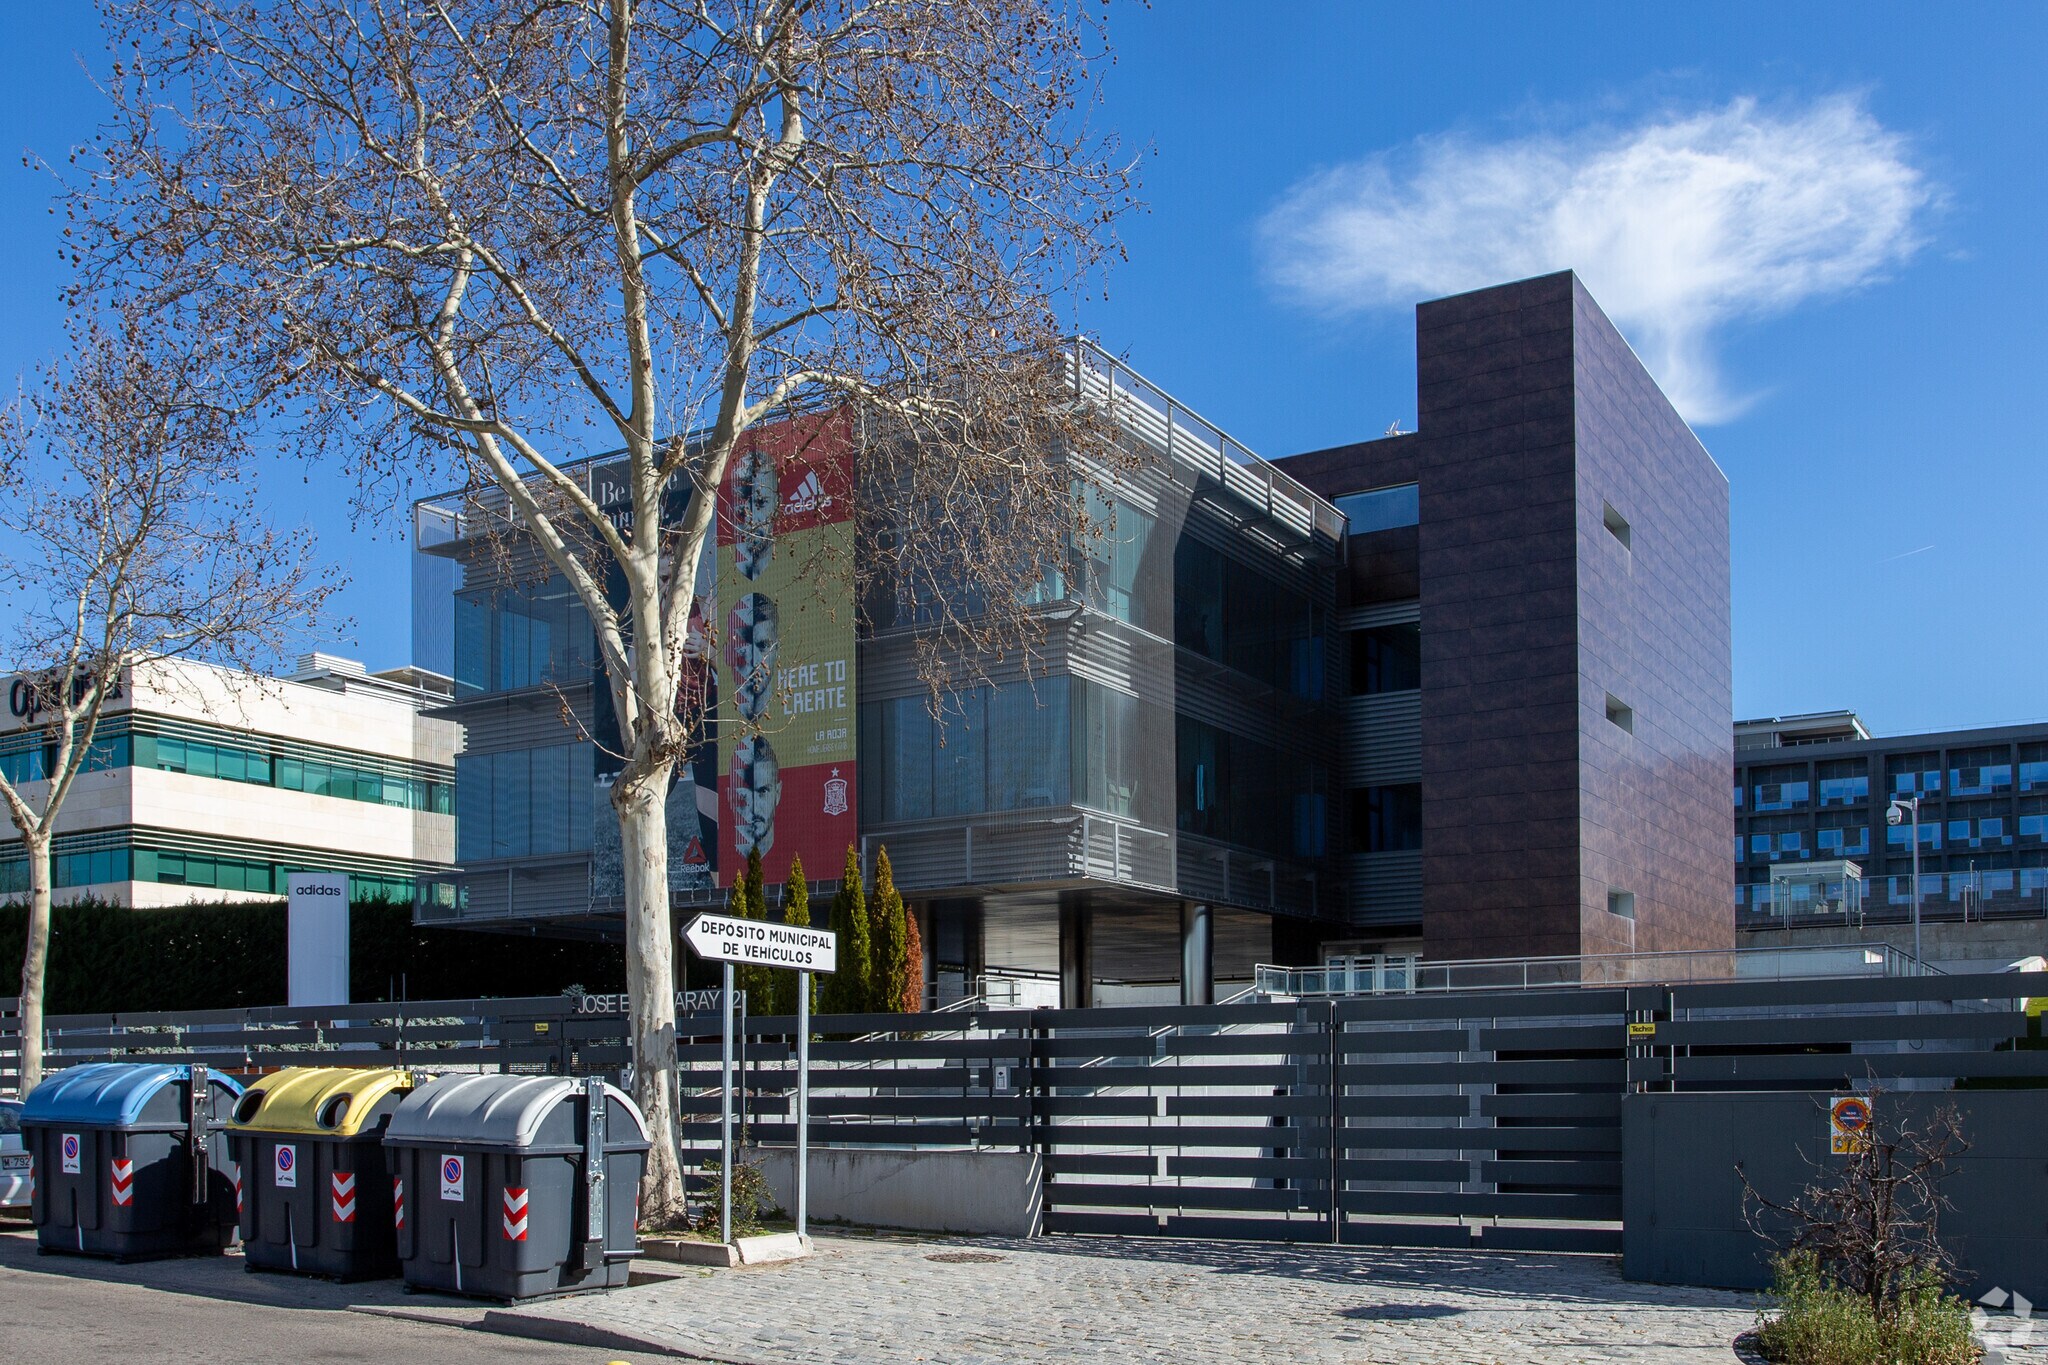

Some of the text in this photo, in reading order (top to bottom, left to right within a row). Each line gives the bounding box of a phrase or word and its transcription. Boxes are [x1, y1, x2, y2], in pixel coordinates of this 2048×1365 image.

[784, 495, 832, 515] adids
[777, 659, 846, 690] HERE TO
[783, 686, 847, 715] CREATE
[815, 728, 847, 741] LA ROJA
[680, 861, 710, 873] Reebok
[296, 884, 341, 896] adidas
[701, 920, 832, 950] DEPÓSITO MUNICIPAL
[723, 941, 813, 964] DE VEHÍCULOS
[577, 994, 617, 1014] JOSE
[620, 990, 720, 1013] EARAY
